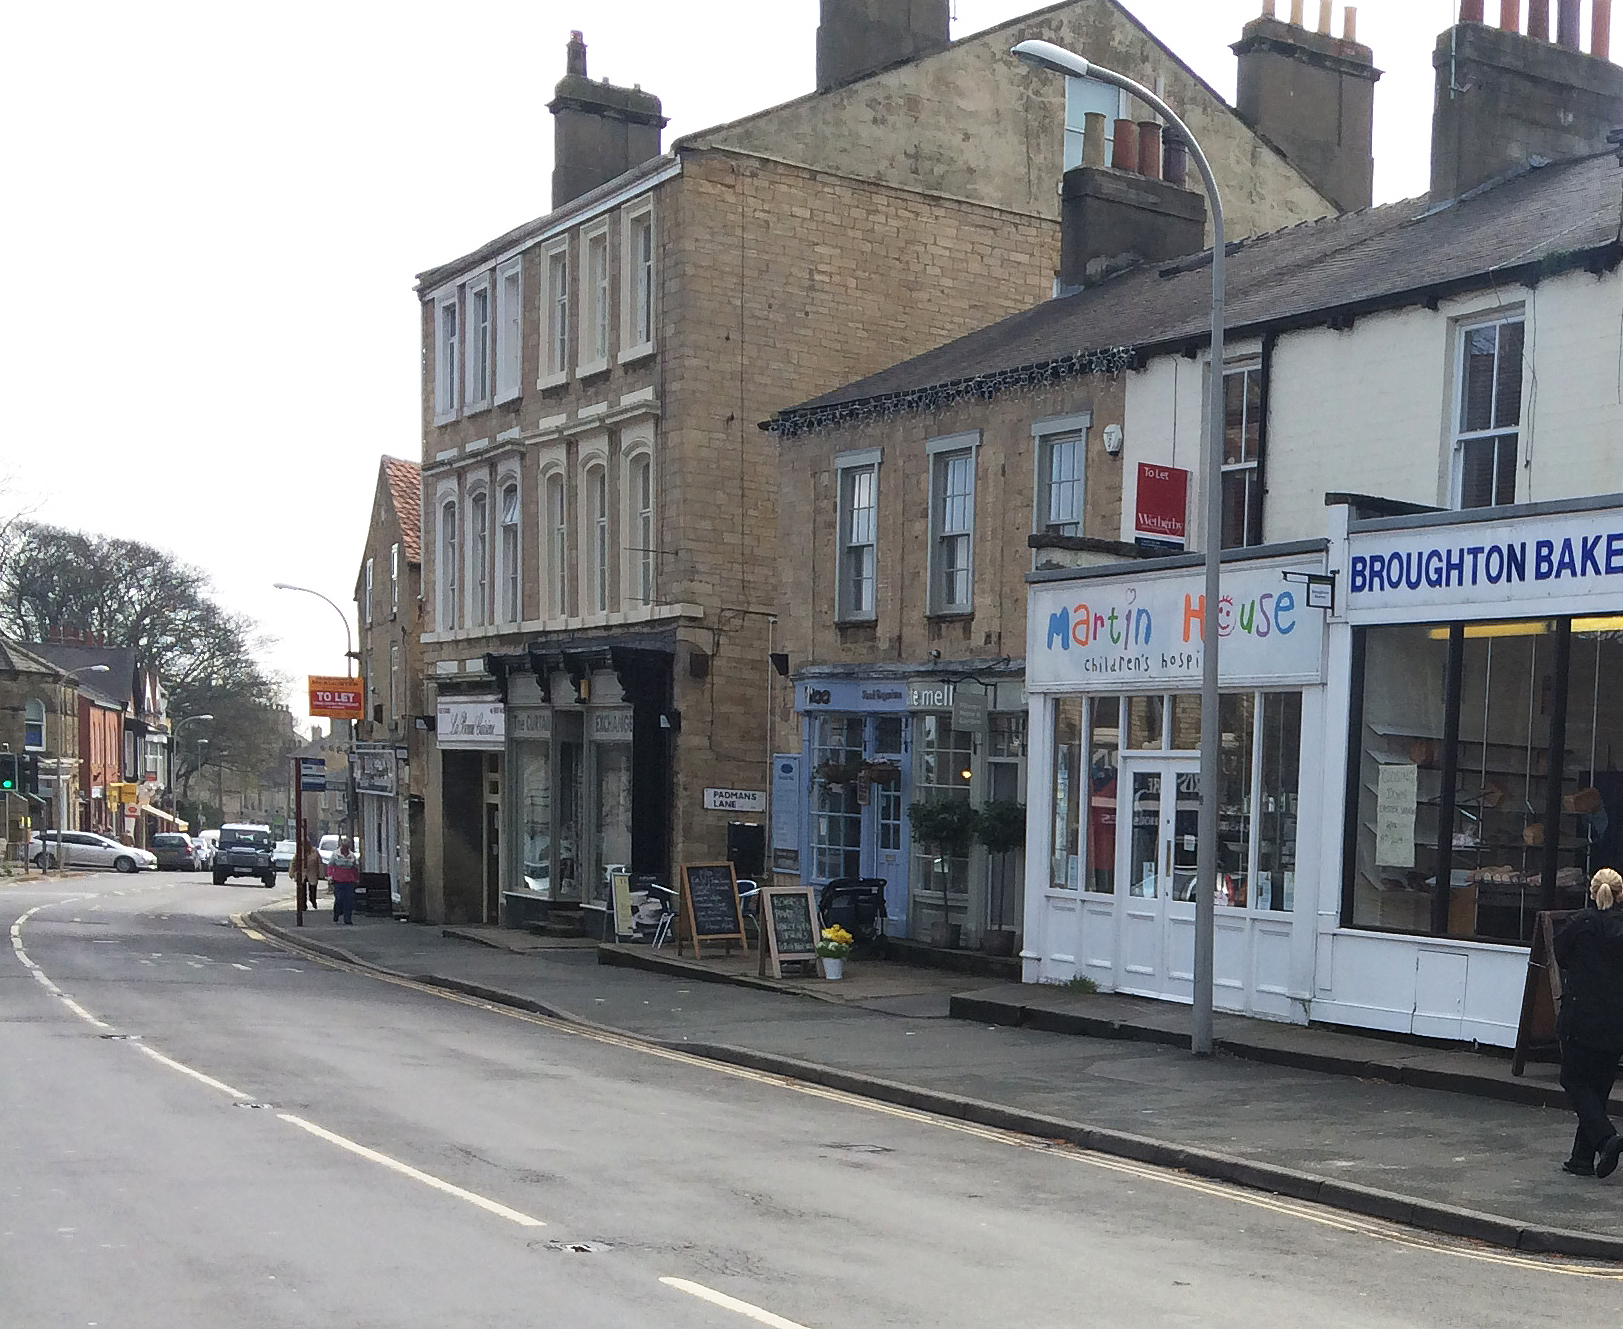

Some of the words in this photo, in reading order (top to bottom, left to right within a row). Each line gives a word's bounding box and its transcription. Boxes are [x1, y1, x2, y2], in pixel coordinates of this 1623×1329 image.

[1144, 466, 1154, 477] To
[1156, 468, 1169, 480] Let
[1350, 542, 1526, 594] BROUGHTON
[1047, 589, 1152, 650] Martin
[1084, 653, 1150, 673] children's
[1161, 651, 1200, 670] hospi
[316, 691, 331, 702] TO
[334, 692, 354, 703] LET
[713, 791, 757, 801] PADMANS
[713, 800, 736, 808] LANE
